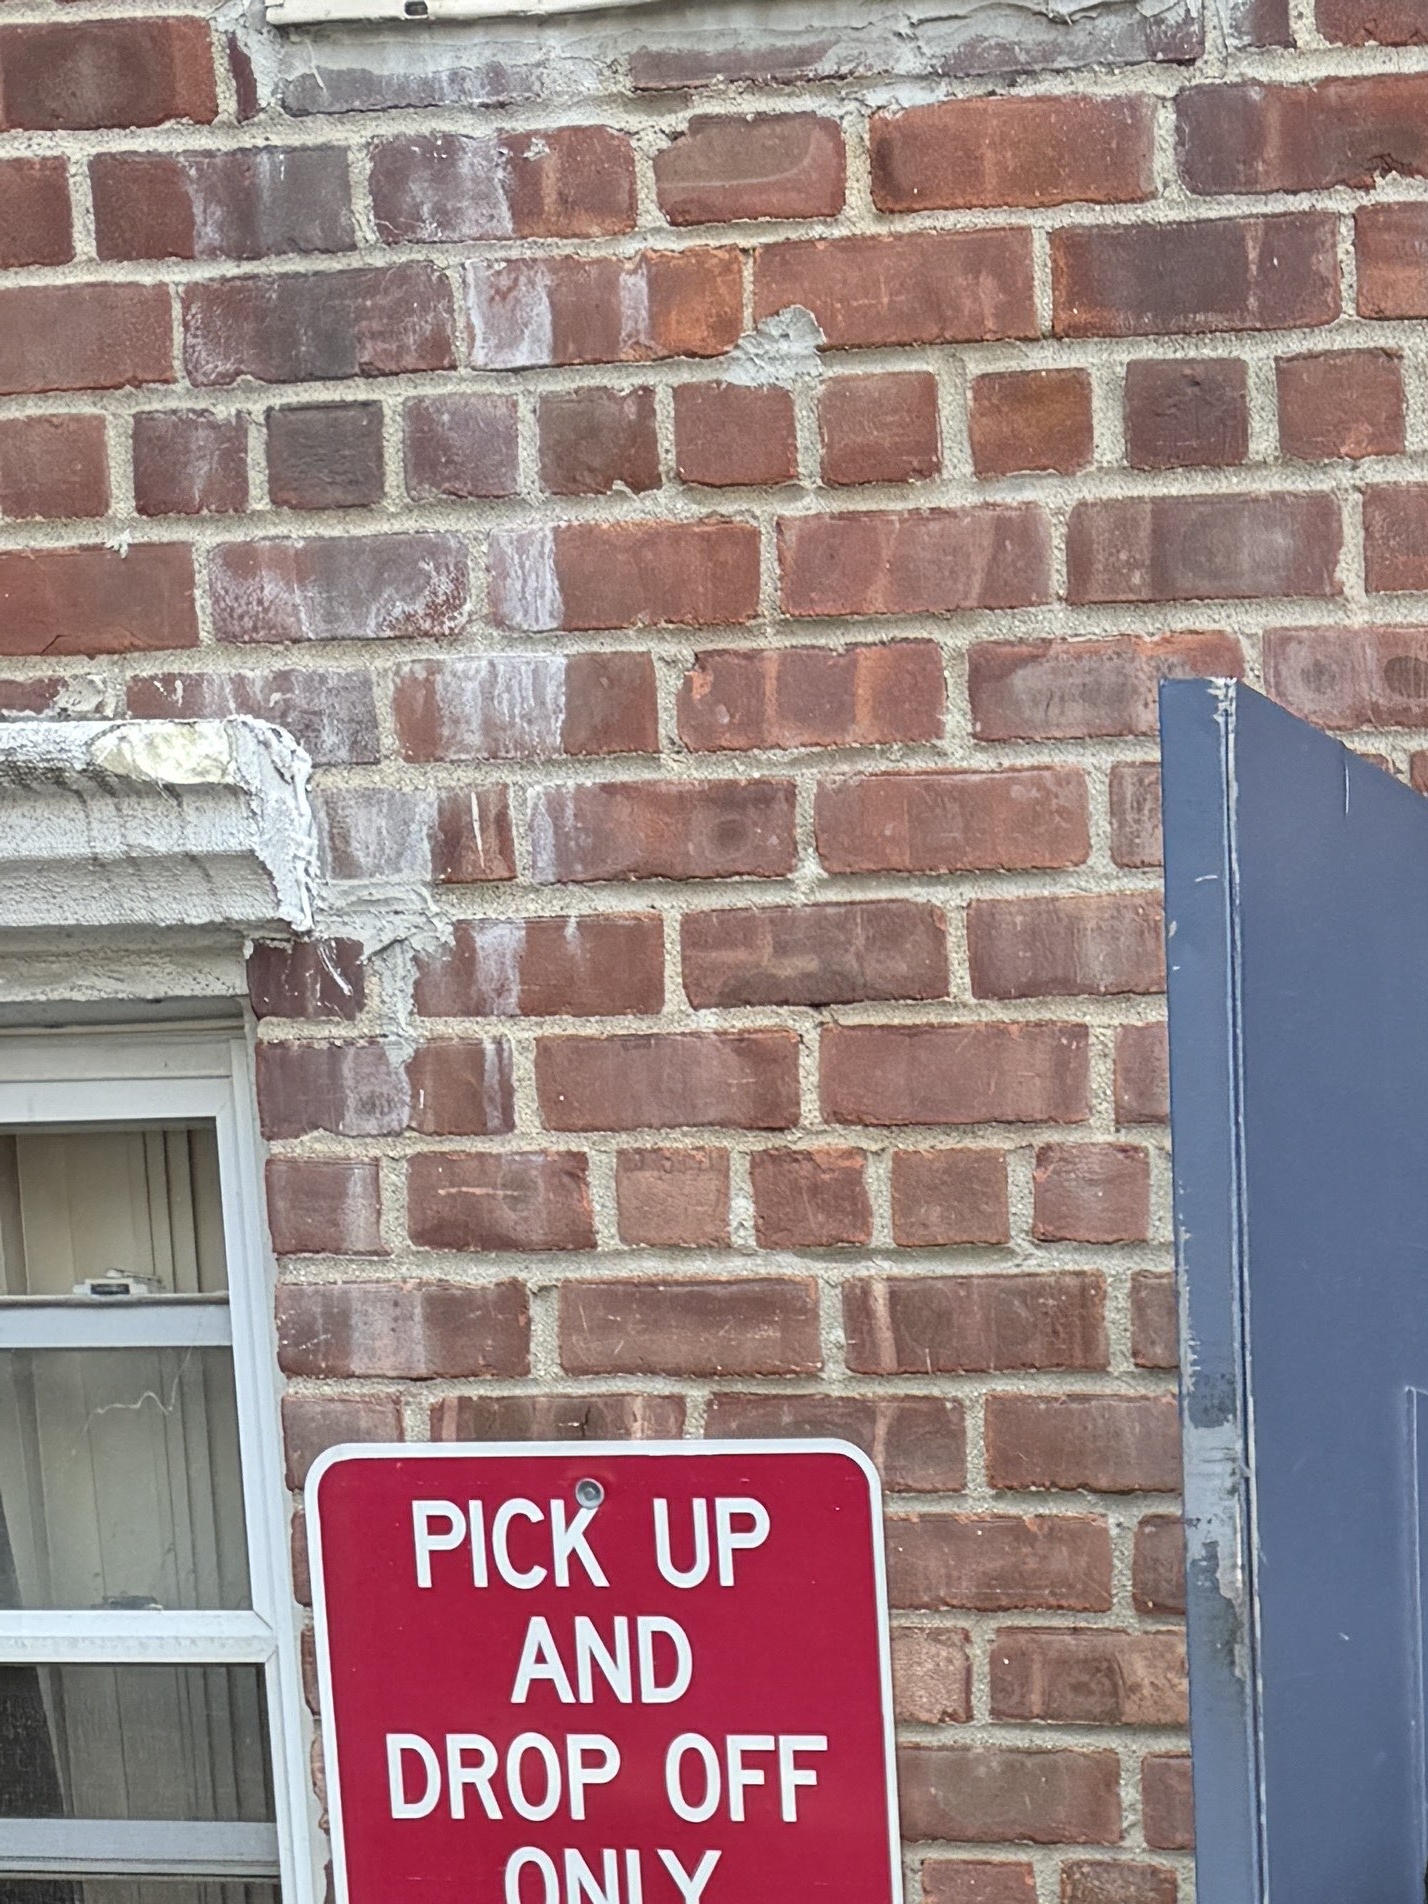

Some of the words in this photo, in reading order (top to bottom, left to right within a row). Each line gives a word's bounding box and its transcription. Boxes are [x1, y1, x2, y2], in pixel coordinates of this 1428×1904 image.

[412, 1498, 610, 1588] PICK
[654, 1498, 770, 1588] UP
[511, 1616, 692, 1704] AND
[386, 1733, 621, 1821] DROP
[666, 1734, 827, 1823] OFF
